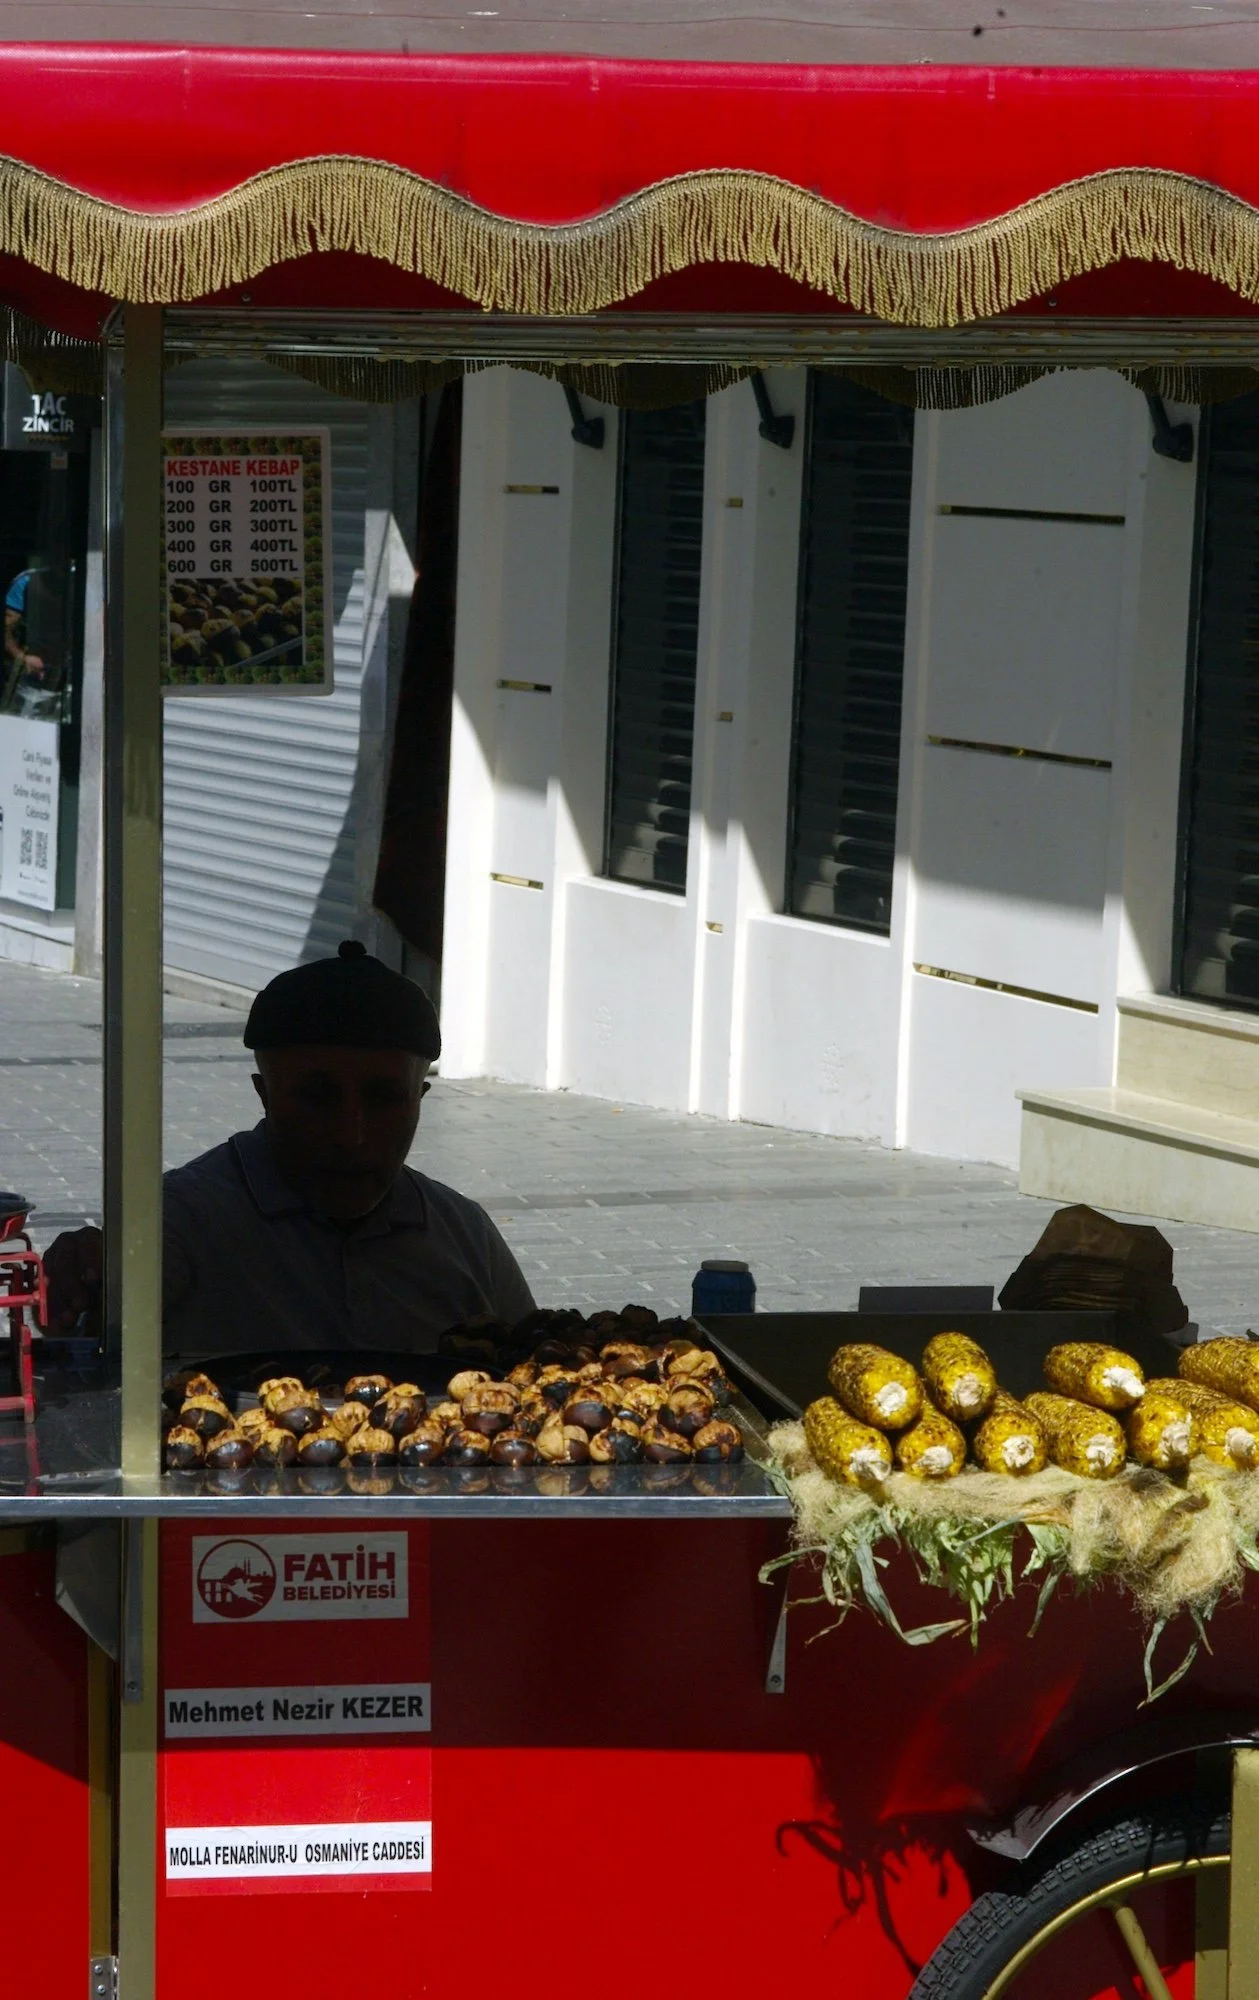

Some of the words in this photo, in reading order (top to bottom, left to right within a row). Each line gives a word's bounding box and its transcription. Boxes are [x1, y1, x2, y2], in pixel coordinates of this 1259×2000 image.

[168, 460, 240, 476] KESTANE
[247, 459, 300, 476] KEBAP
[167, 481, 194, 493] 100
[209, 480, 231, 493] GR
[250, 480, 297, 493] 100TL
[167, 500, 194, 513] 200
[209, 500, 231, 513] GR
[250, 500, 297, 513] 200TL
[168, 520, 195, 533] 300
[210, 520, 232, 533] GR
[250, 519, 297, 532] 300TL
[168, 540, 195, 553] 400
[210, 540, 232, 552] GR
[251, 539, 297, 552] 400TL
[168, 560, 195, 573] 600
[210, 560, 232, 572] GR
[251, 559, 298, 572] 500TL
[284, 1544, 395, 1582] FATİH
[283, 1581, 396, 1601] BELEDİYESİ
[169, 1699, 264, 1723] Mehmet
[273, 1698, 334, 1721] Nezir
[342, 1696, 423, 1719] KEZER
[170, 1846, 211, 1866] MOLLA
[215, 1841, 297, 1865] FENARİNUR-U
[305, 1838, 368, 1863] OSMANİYE
[372, 1836, 424, 1861] CADDESİ
